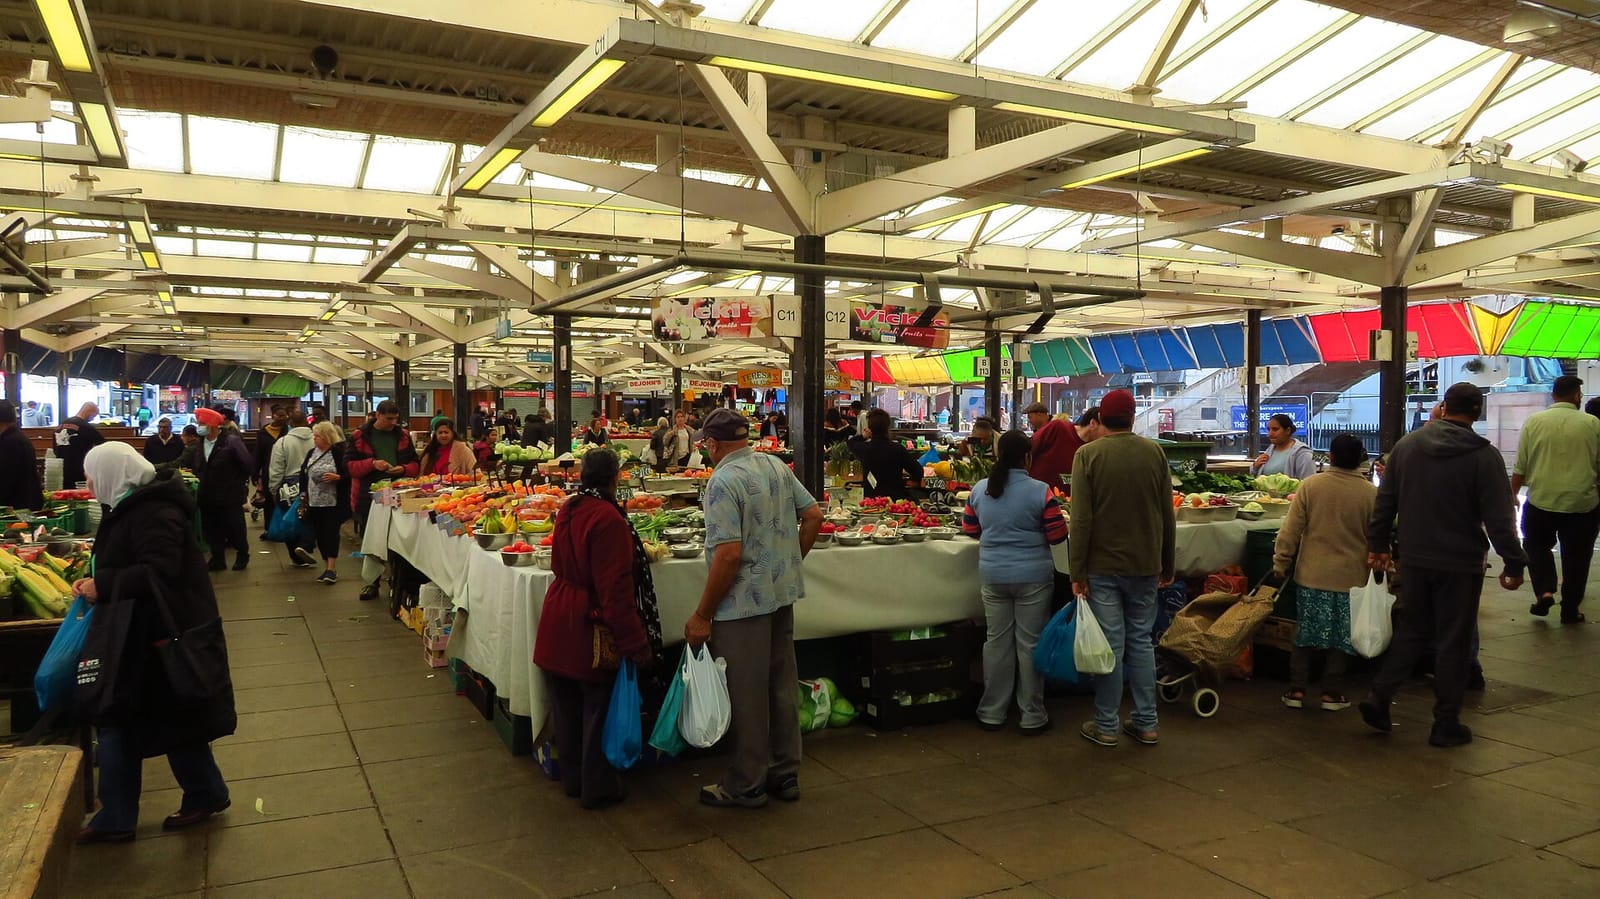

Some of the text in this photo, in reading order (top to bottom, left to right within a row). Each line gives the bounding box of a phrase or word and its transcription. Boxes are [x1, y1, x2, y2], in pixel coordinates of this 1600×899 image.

[595, 34, 605, 55] C11
[777, 309, 796, 321] C11
[825, 310, 846, 323] C12
[900, 327, 923, 338] fruits
[629, 379, 662, 387] DEJOHN'S
[689, 380, 722, 389] DEJOHN'S
[1234, 421, 1245, 429] THE
